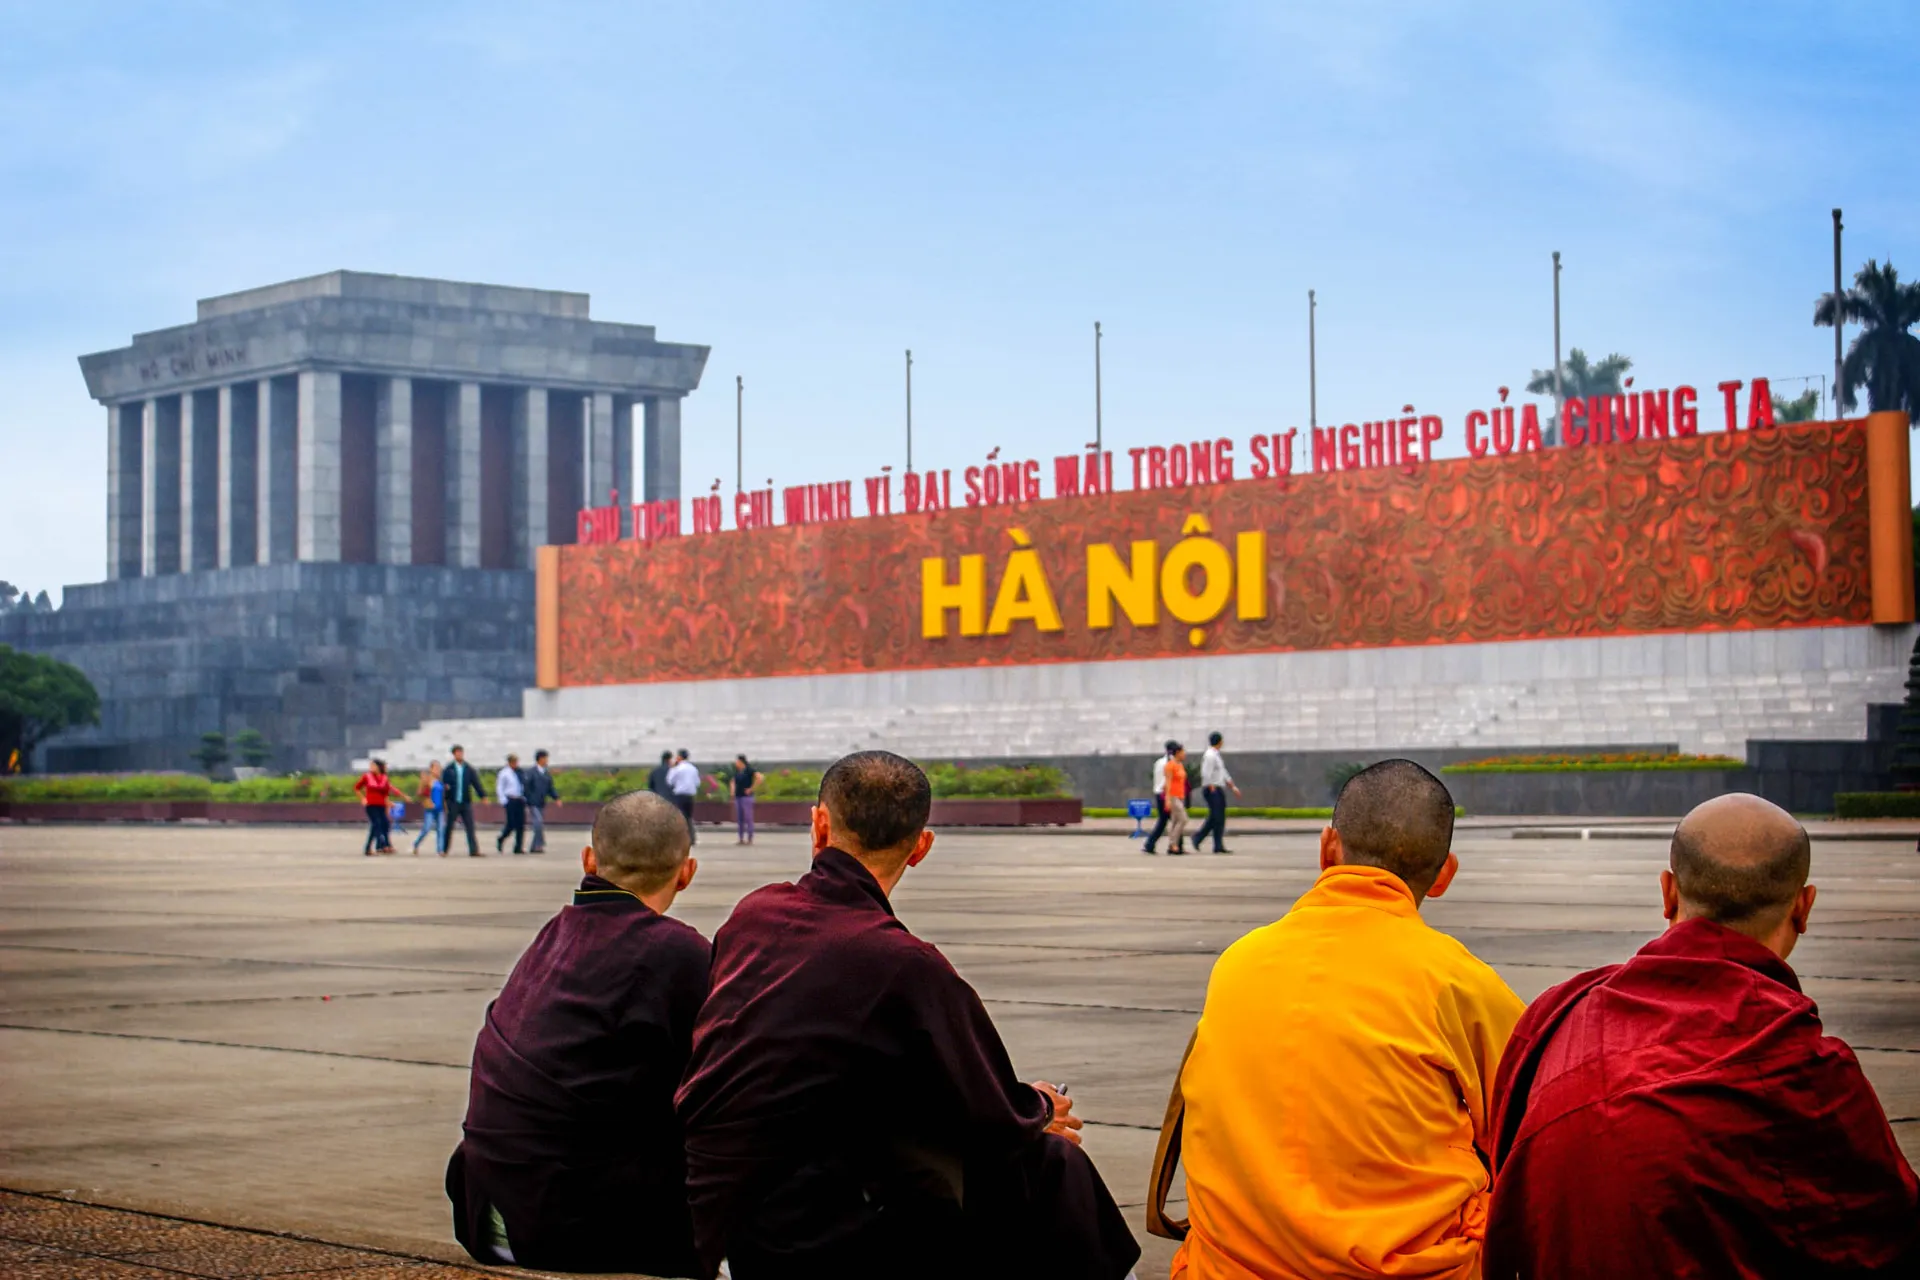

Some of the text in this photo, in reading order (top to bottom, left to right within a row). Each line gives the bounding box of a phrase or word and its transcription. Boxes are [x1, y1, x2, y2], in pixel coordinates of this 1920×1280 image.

[577, 488, 621, 545] CHỦ
[630, 499, 681, 550] TỊCH
[783, 479, 852, 526] MINH
[901, 468, 951, 521] ĐẠI
[964, 446, 1040, 508] SỐNG
[1054, 442, 1112, 498] MÃI
[1128, 438, 1234, 492] TRONG
[1250, 427, 1298, 492] SỰ
[1313, 405, 1442, 475] NGHIỆP
[1465, 386, 1543, 459] CỦA
[1562, 376, 1698, 448] CHÚNG
[1718, 377, 1775, 431] TA
[921, 513, 1267, 648] HÀ NỘI
